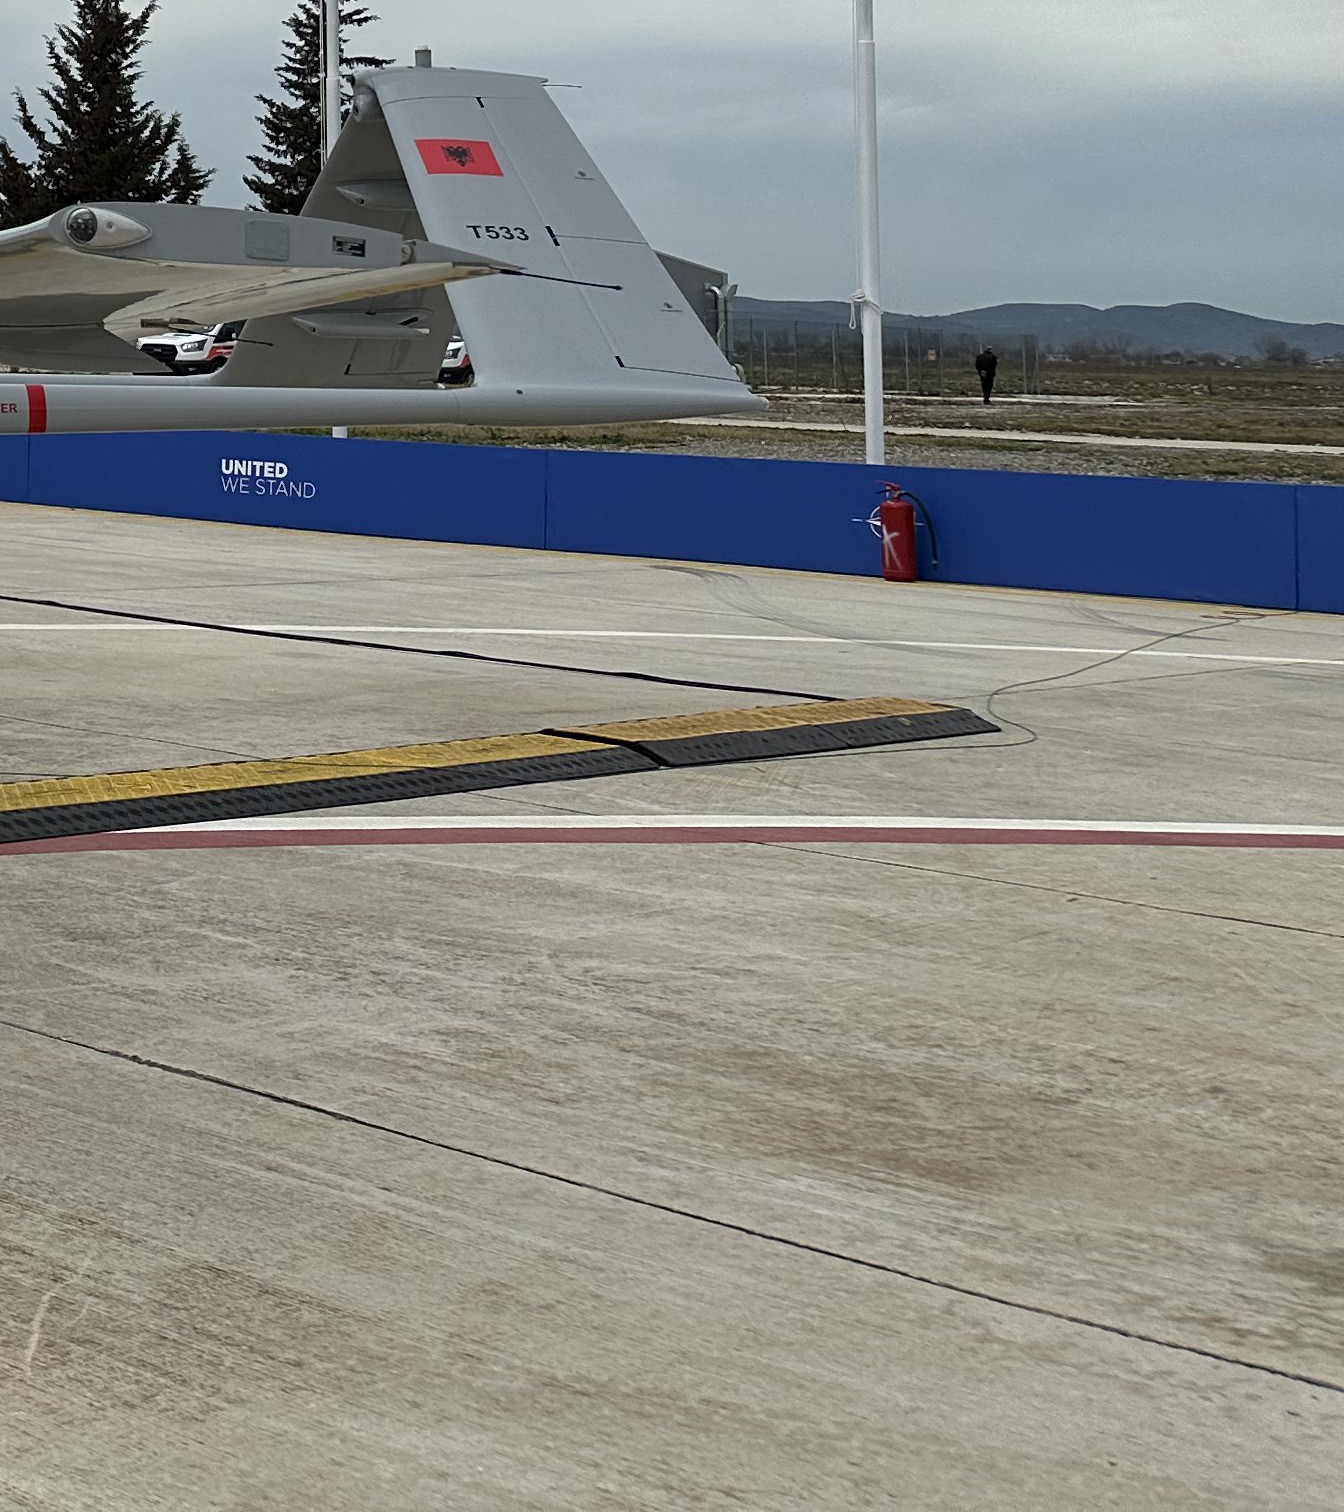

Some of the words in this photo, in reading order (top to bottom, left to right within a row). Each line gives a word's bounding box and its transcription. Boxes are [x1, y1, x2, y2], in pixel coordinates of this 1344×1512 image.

[465, 224, 529, 241] T533
[221, 458, 288, 478] UNITED
[221, 476, 250, 494] WE
[255, 478, 316, 499] STAND
